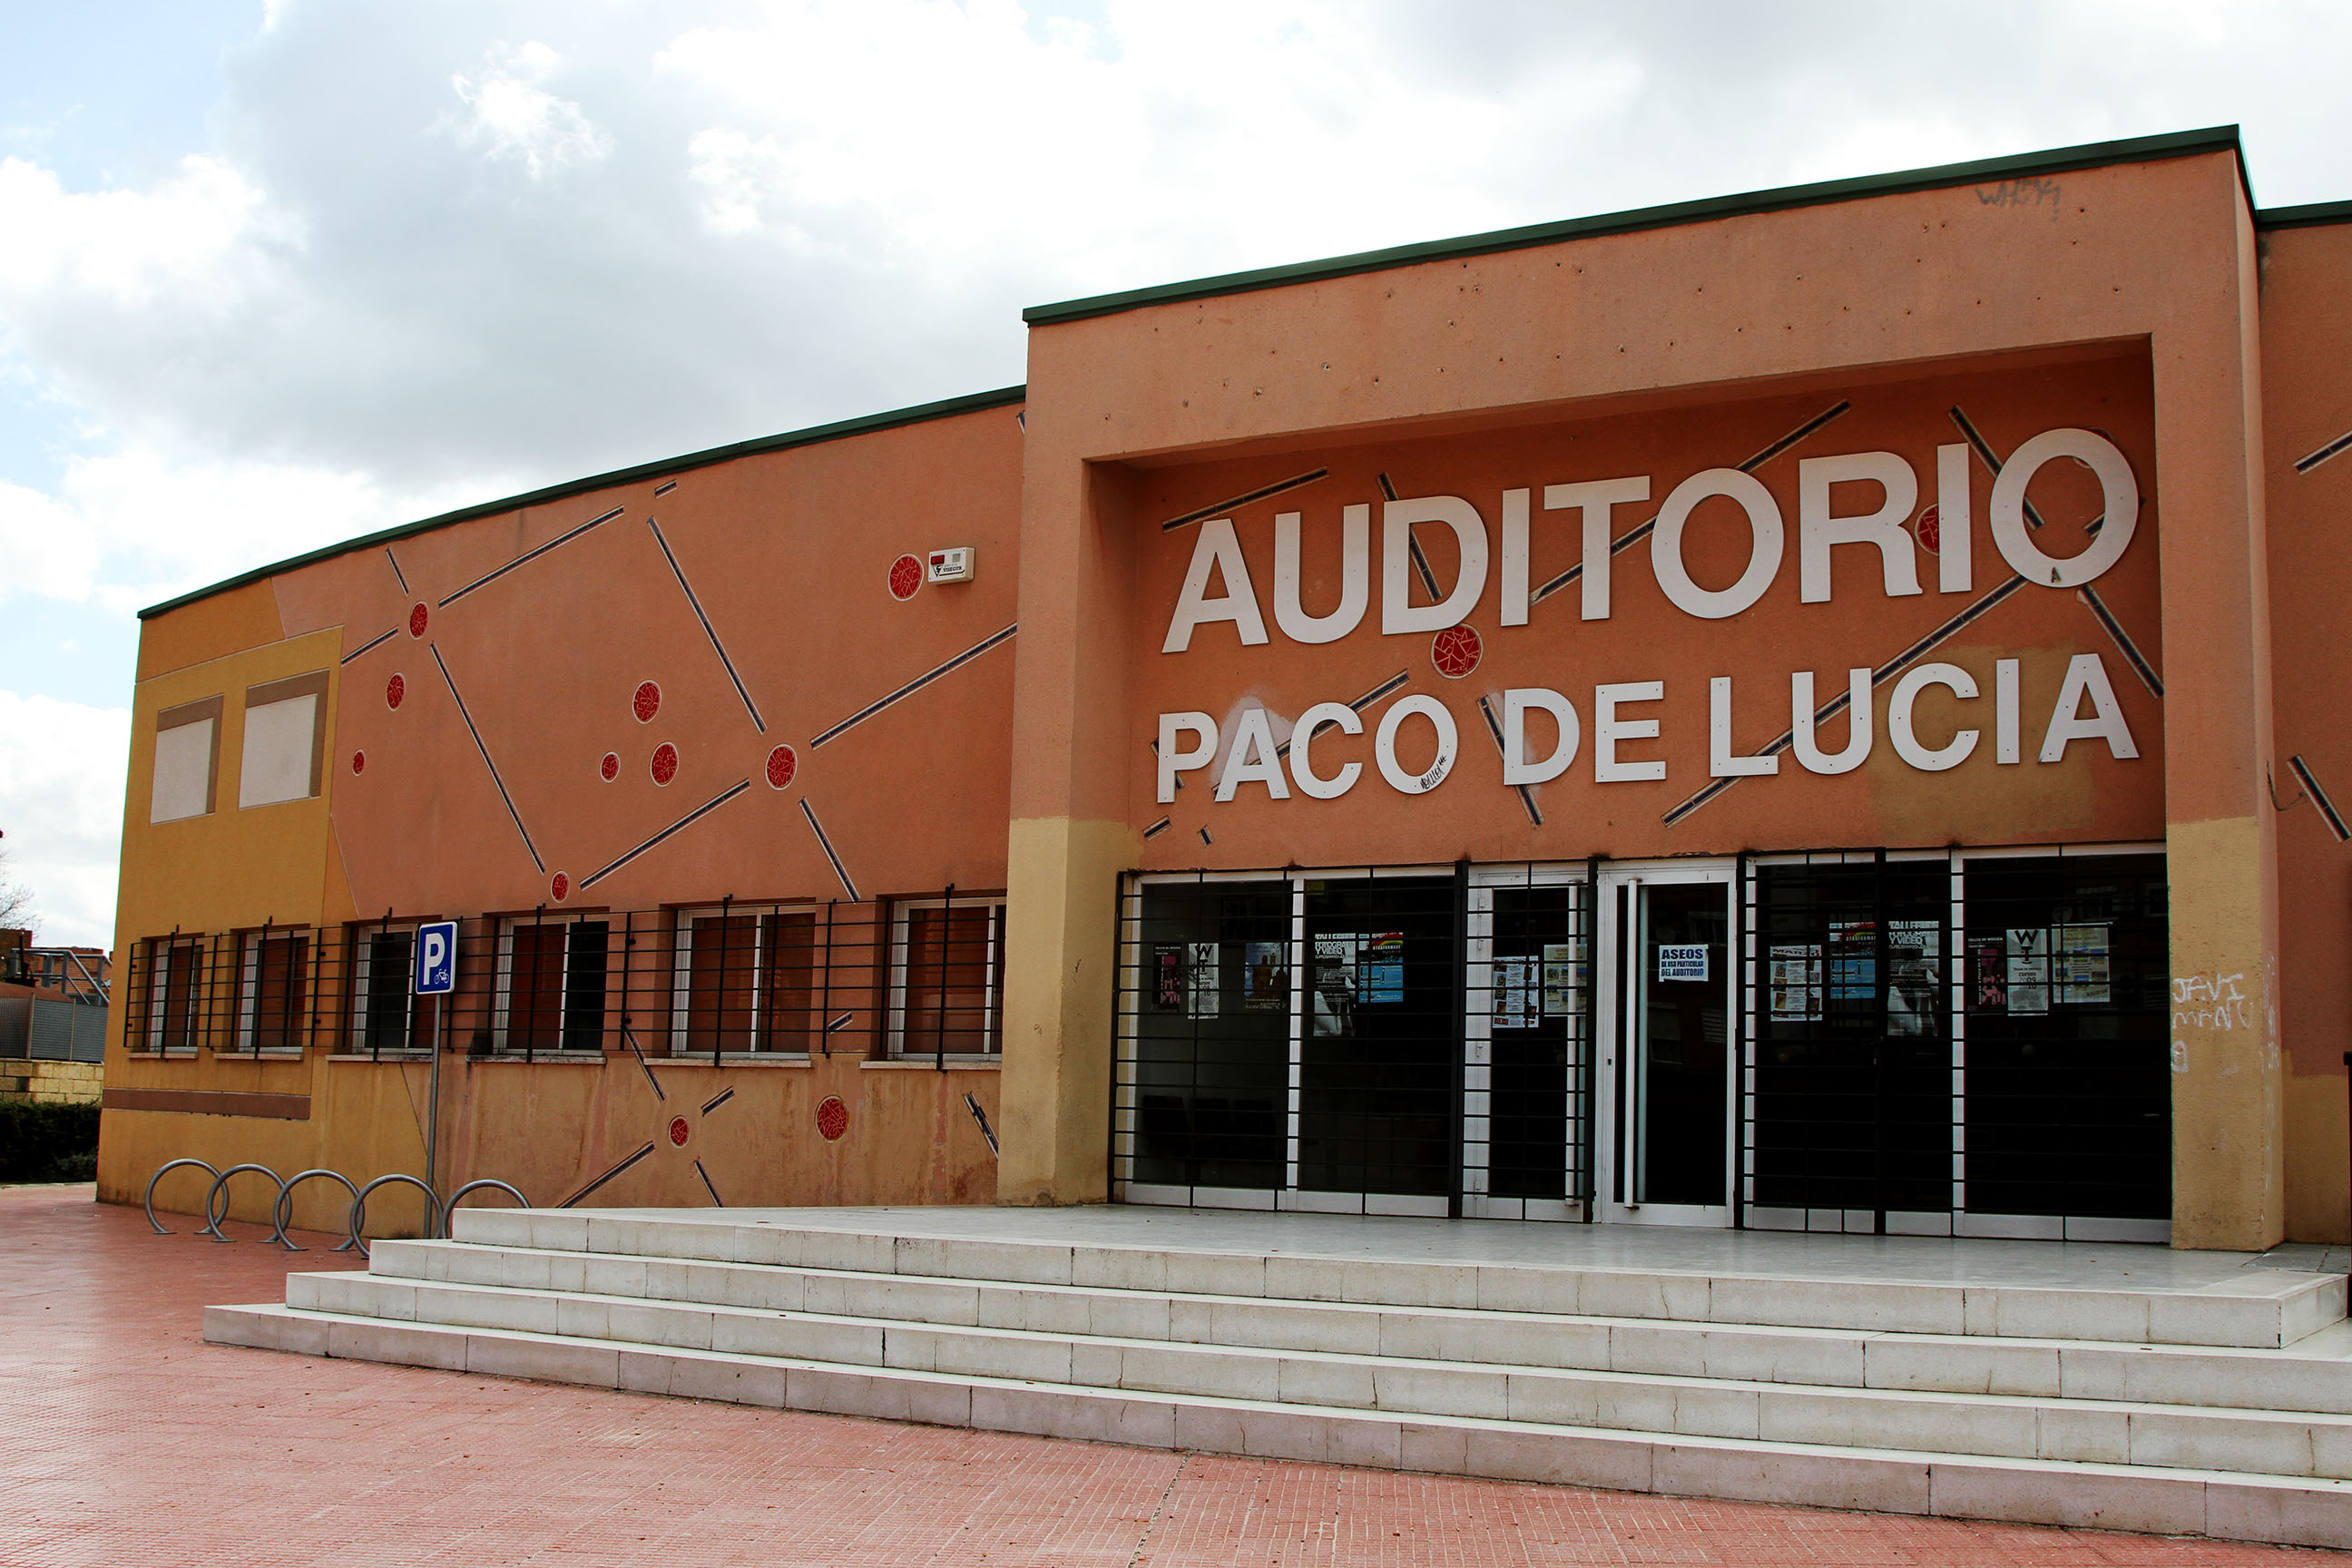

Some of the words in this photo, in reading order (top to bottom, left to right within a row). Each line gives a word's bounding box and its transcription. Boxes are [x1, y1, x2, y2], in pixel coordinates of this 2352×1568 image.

[1161, 427, 2139, 652] AUDITORIO
[1157, 694, 1457, 803] PACO
[1504, 681, 1666, 785] DE
[1710, 653, 2140, 777] LUCIA
[423, 932, 446, 985] P
[1661, 948, 1703, 959] ASEOS
[1661, 968, 1671, 976] DEL
[1672, 968, 1704, 976] AUDITORIO
